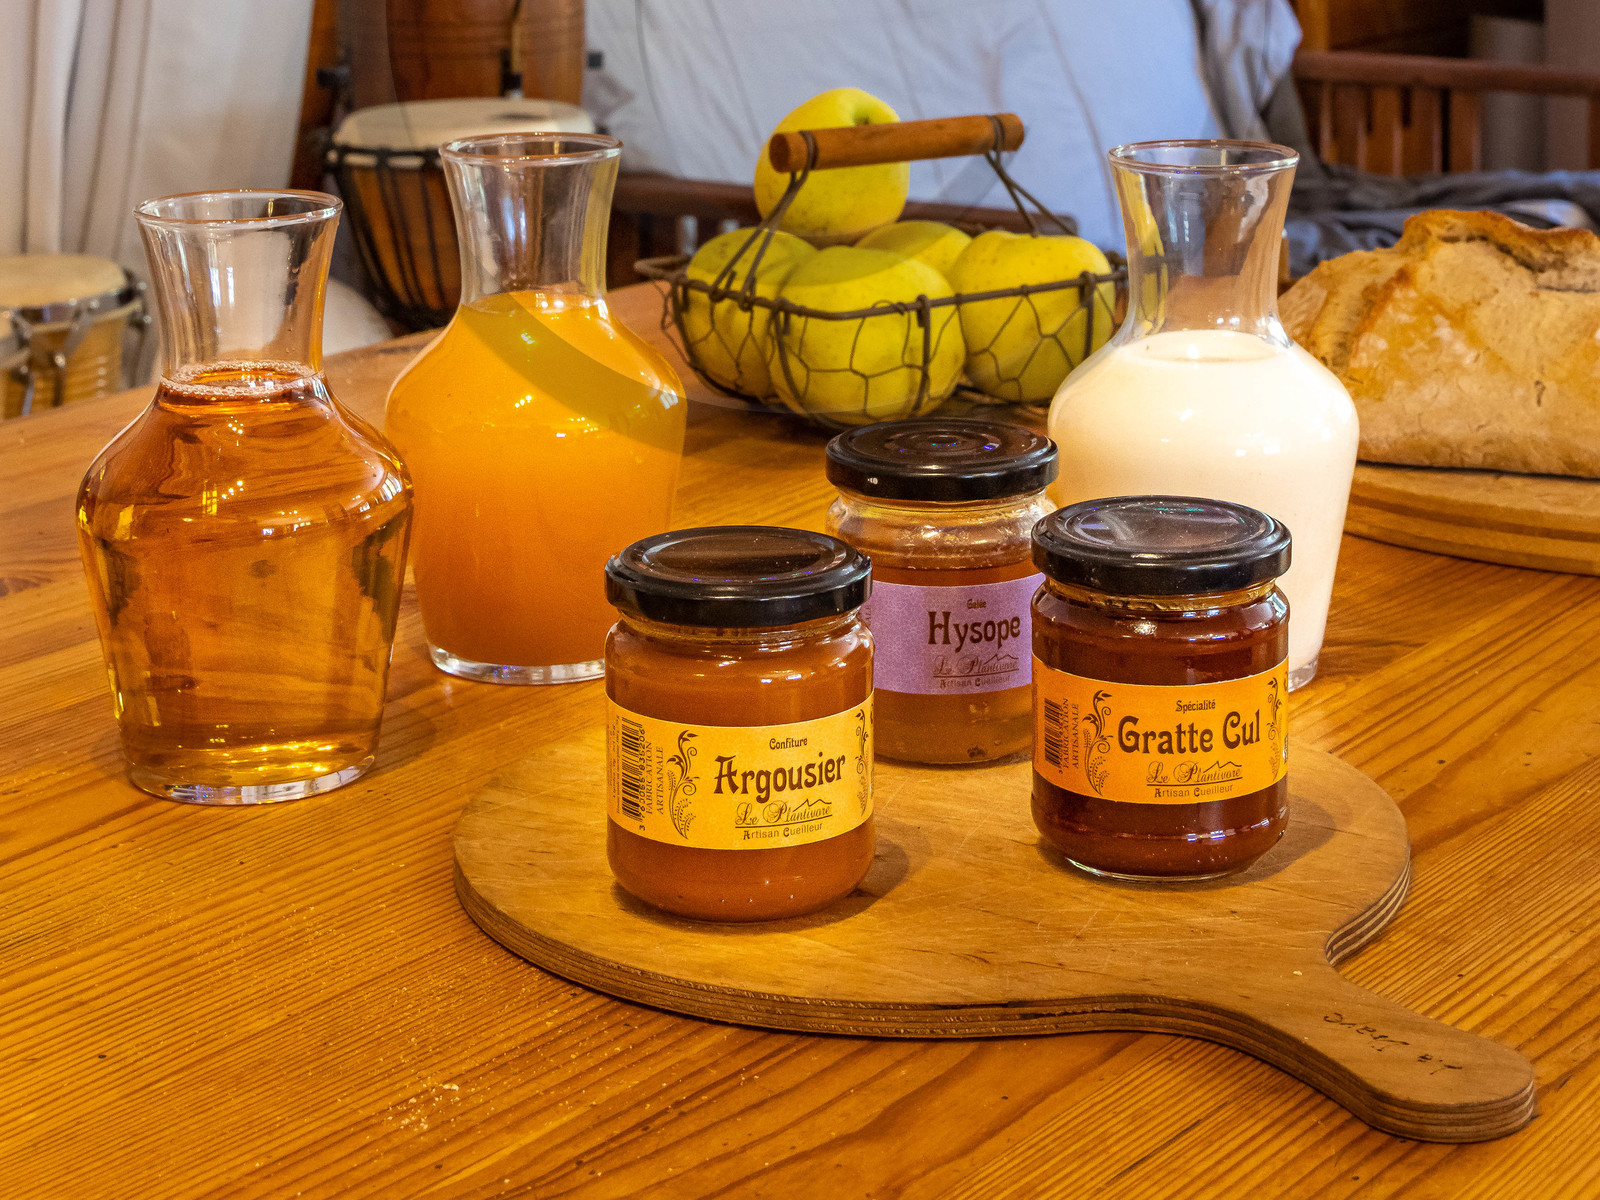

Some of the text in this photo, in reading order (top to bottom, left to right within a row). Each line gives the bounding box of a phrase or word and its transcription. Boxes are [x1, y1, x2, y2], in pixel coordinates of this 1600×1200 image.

[928, 611, 1021, 653] Hysope
[1175, 699, 1216, 714] Spécialité
[769, 737, 808, 750] Confiture
[1118, 708, 1261, 755] Gratte Cul
[645, 740, 653, 815] FABRICATION
[656, 746, 664, 815] ARTISANALE
[713, 751, 846, 804] Argousier
[1146, 760, 1242, 784] Le Plantivore
[1154, 784, 1234, 798] Artisan Cueilleur
[735, 799, 831, 826] Le Plantivore
[743, 822, 824, 840] Artisan Cueilleur
